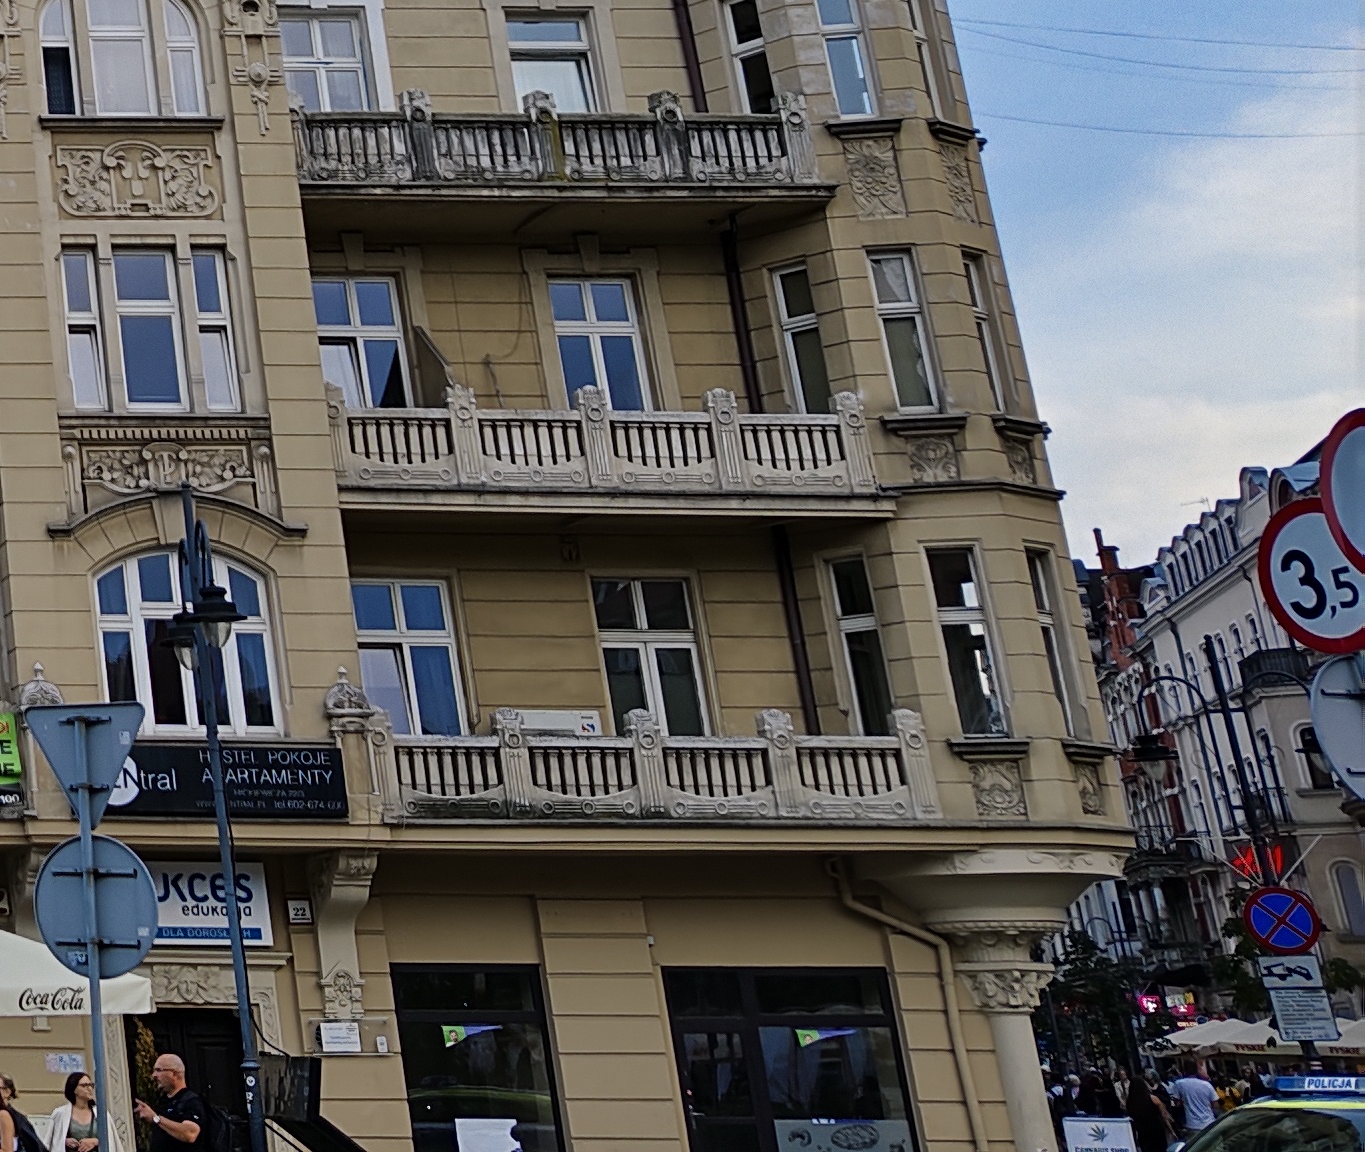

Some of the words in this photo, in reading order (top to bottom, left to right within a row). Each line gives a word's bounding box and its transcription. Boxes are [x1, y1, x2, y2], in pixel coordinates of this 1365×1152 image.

[1281, 550, 1359, 619] 3,5
[199, 750, 255, 765] HSTEL
[269, 751, 331, 765] POKOJE
[202, 768, 333, 785] AARTAMENTY
[292, 906, 307, 917] 22
[162, 928, 184, 937] DLA
[187, 928, 251, 938] DOROSŁH
[1307, 1077, 1353, 1089] POLICJA
